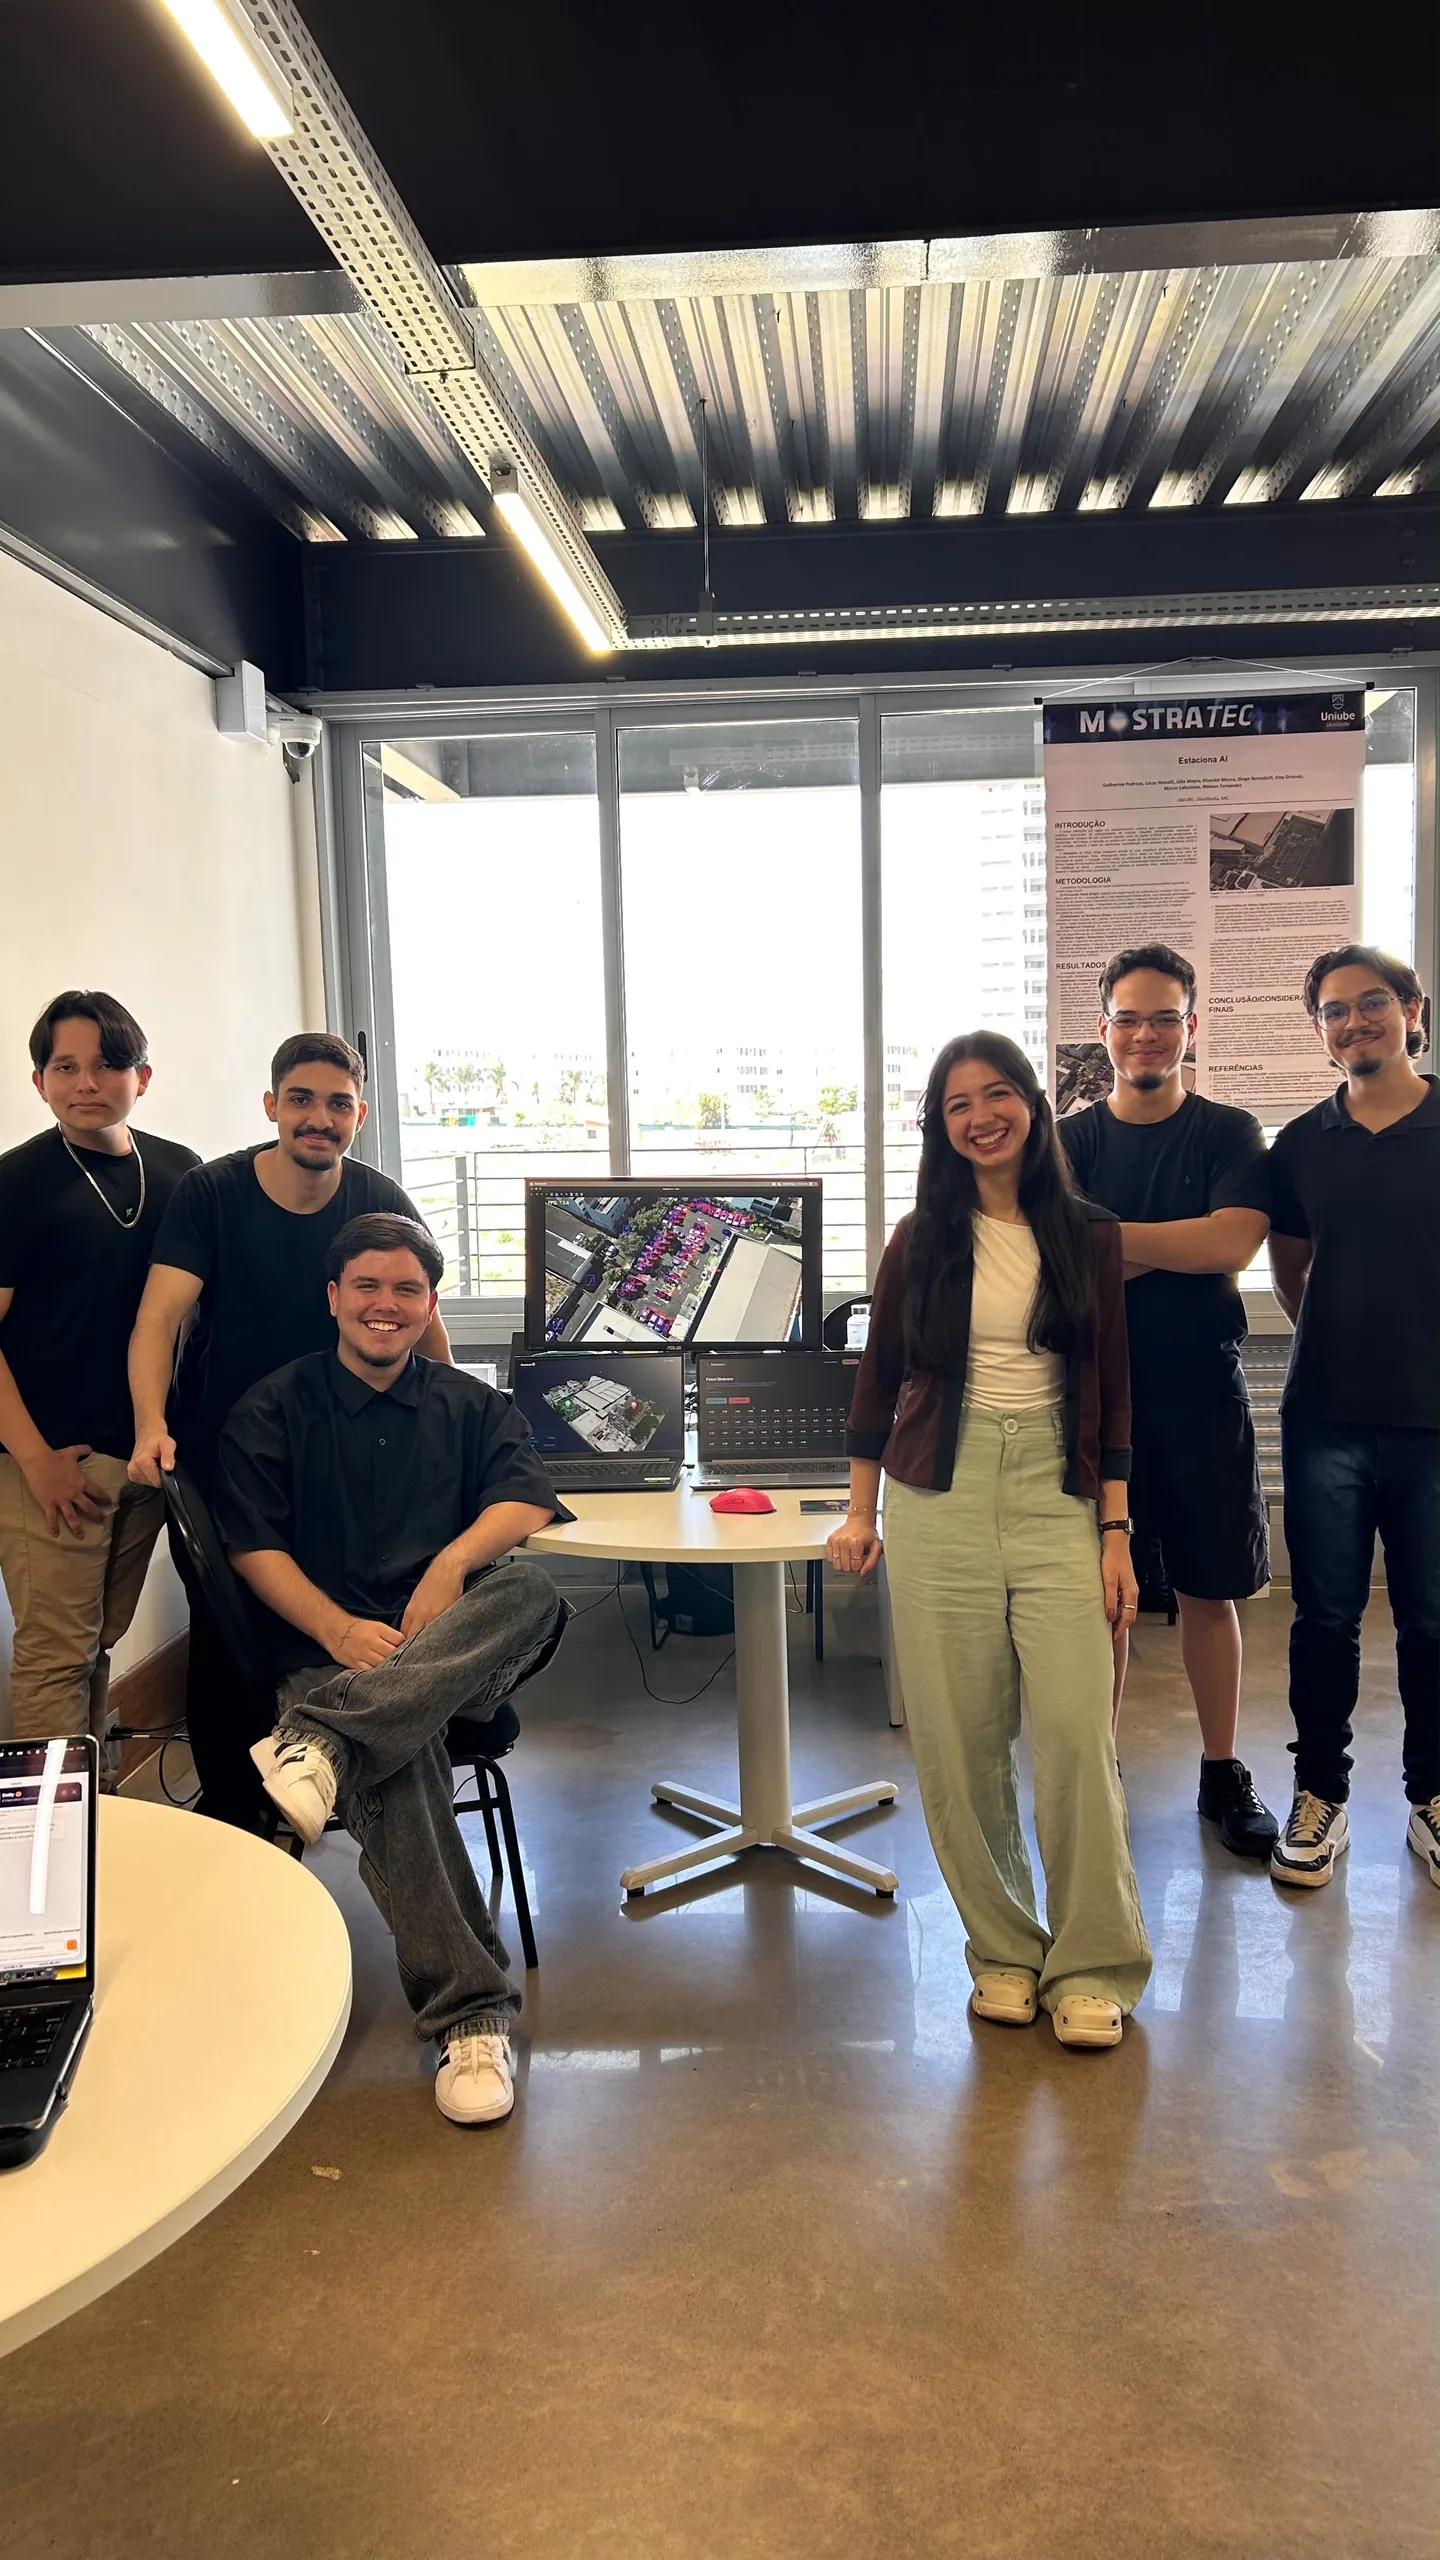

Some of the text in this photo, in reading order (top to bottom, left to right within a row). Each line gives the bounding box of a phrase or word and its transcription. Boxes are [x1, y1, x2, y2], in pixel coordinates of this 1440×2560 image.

[1320, 710, 1356, 721] Uniube
[1178, 755, 1228, 765] Estaciona AI
[1054, 820, 1106, 829] INTRODUÇÃO
[1055, 876, 1112, 885] METODOLOGIA
[1056, 961, 1107, 969] RESULTADOS
[1208, 1064, 1263, 1072] REFERÊNCIAS
